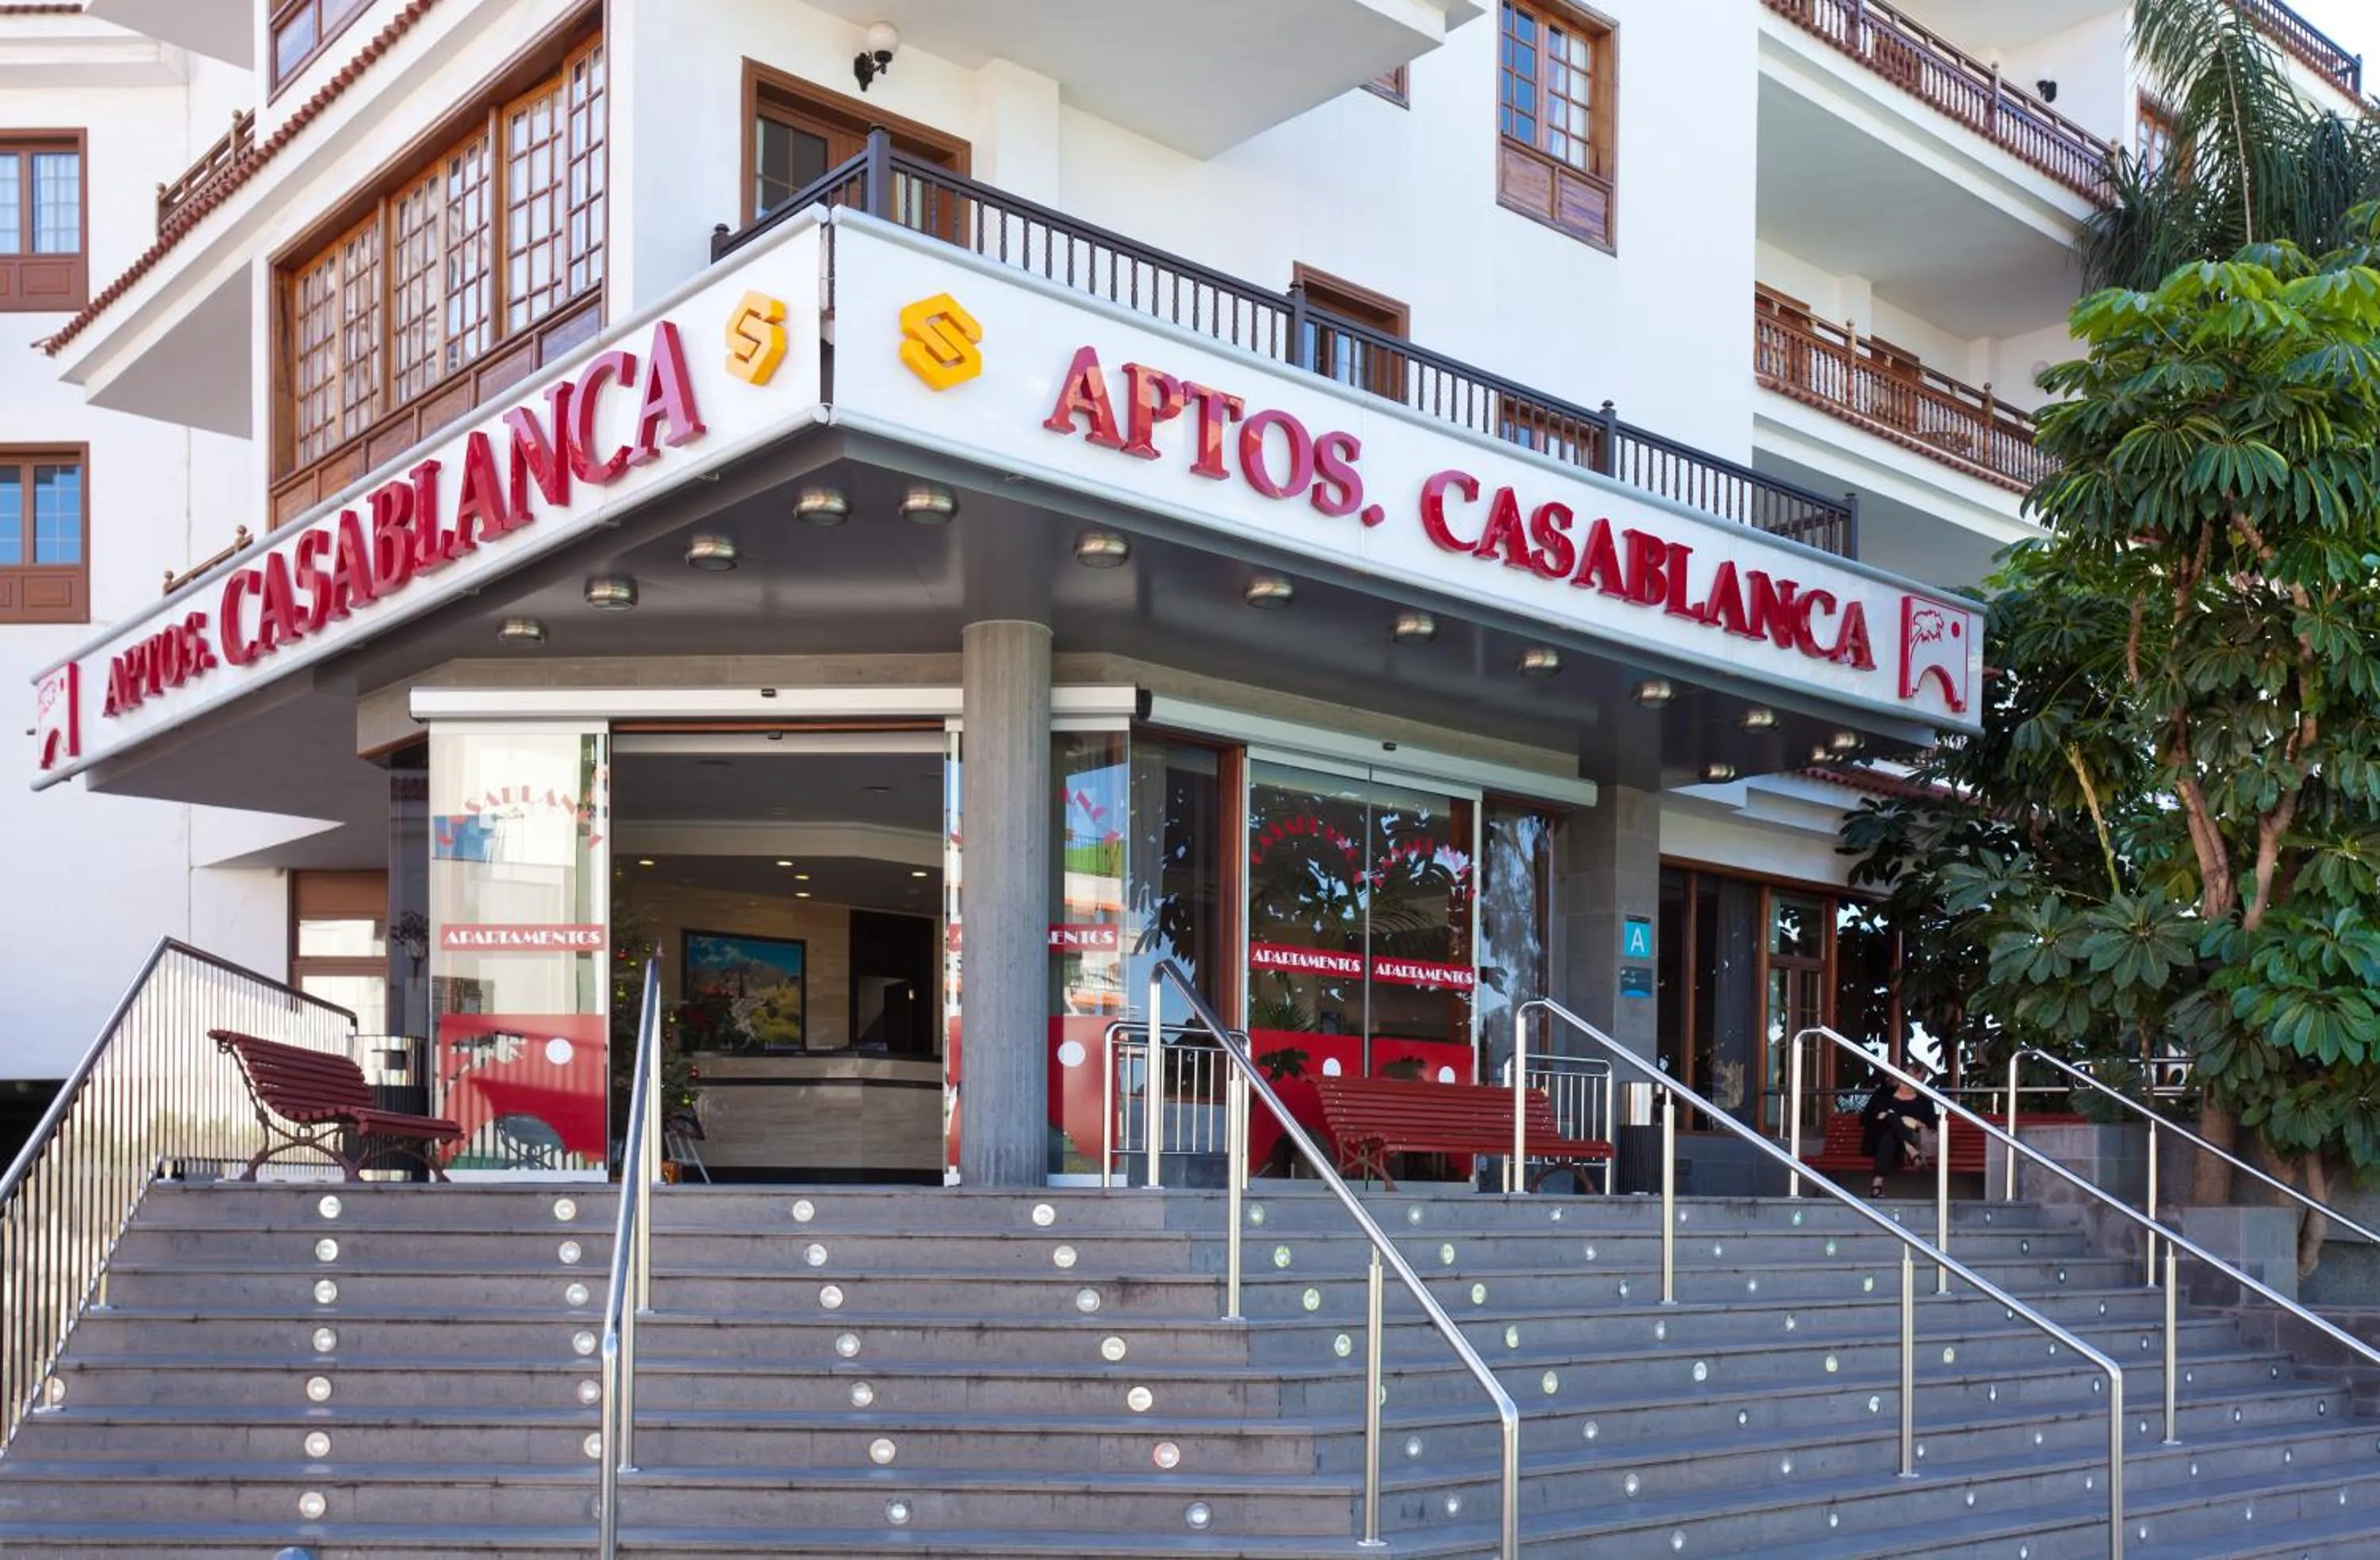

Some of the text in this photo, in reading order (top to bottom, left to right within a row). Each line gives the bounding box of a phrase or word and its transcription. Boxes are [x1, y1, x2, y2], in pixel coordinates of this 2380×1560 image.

[219, 320, 708, 667] CASABLANCA
[1042, 344, 1878, 672] APTOS. CASABLANCA
[444, 929, 602, 946] APARTAMENTOS
[1630, 926, 1645, 953] A
[1253, 948, 1361, 973] APARTAMENTOS
[1375, 963, 1474, 986] APARTAMENTOS
